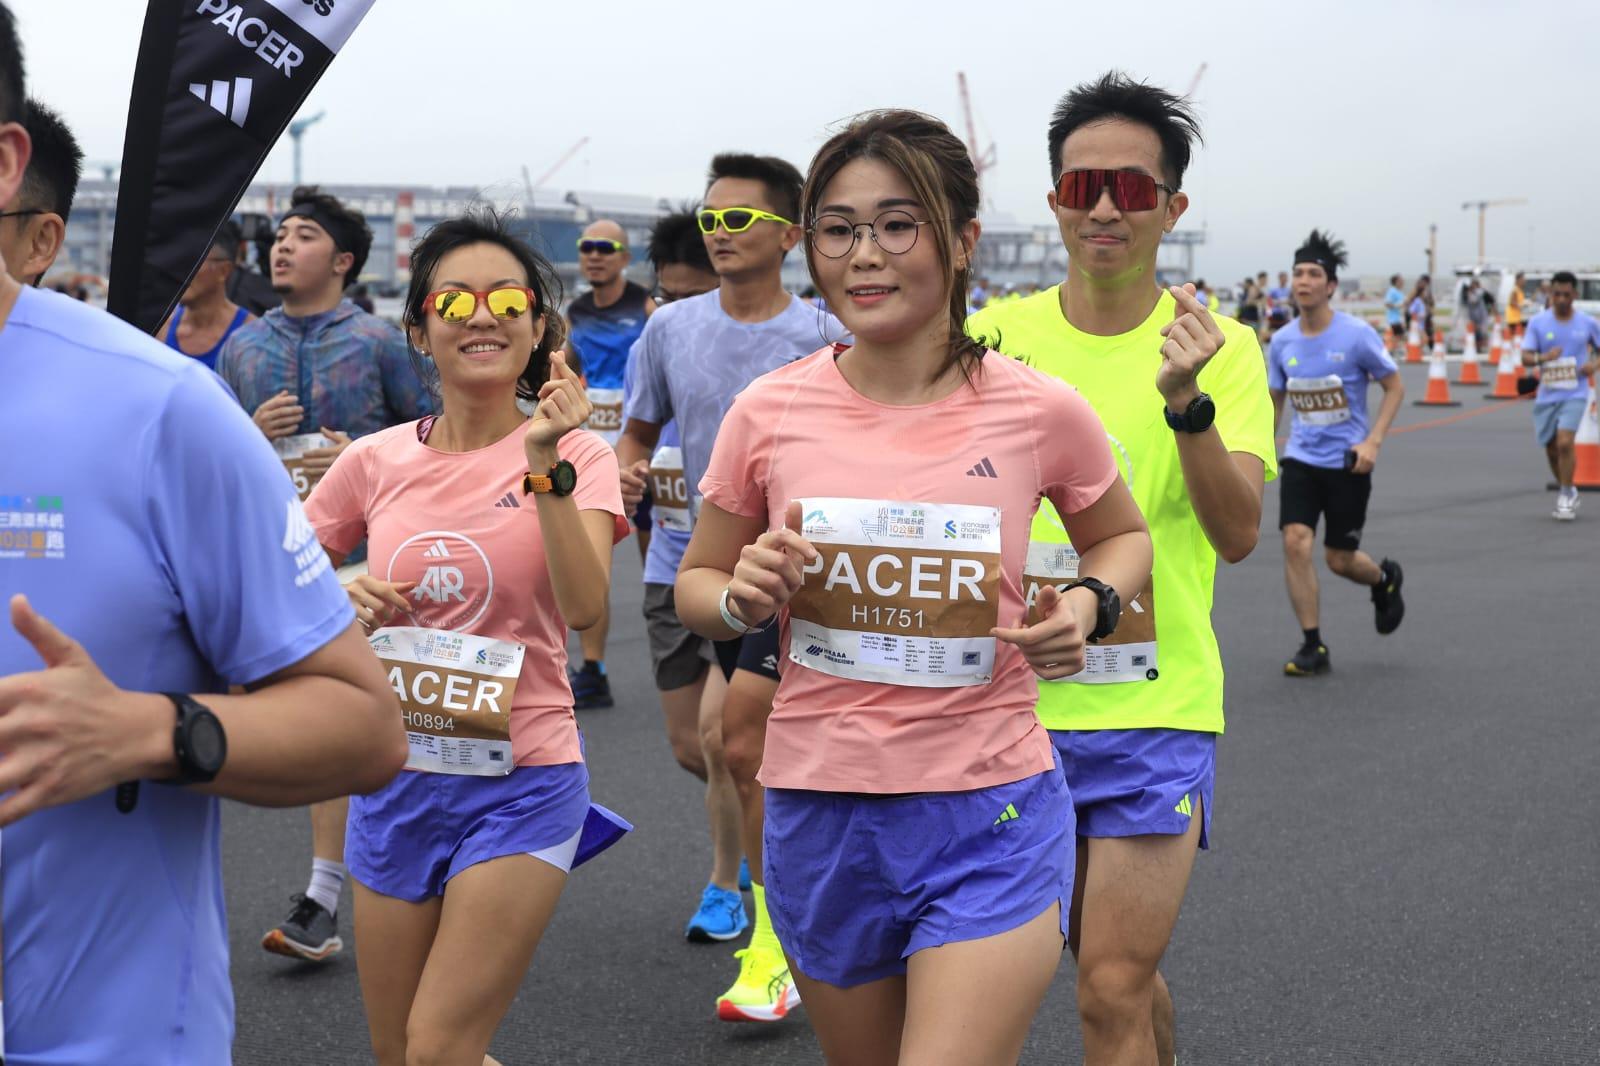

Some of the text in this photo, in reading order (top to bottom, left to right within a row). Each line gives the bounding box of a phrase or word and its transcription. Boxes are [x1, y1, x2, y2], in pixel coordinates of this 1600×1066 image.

[196, 0, 305, 78] PACER
[800, 551, 987, 601] PACER
[851, 604, 926, 629] H1751
[400, 709, 455, 732] H0894
